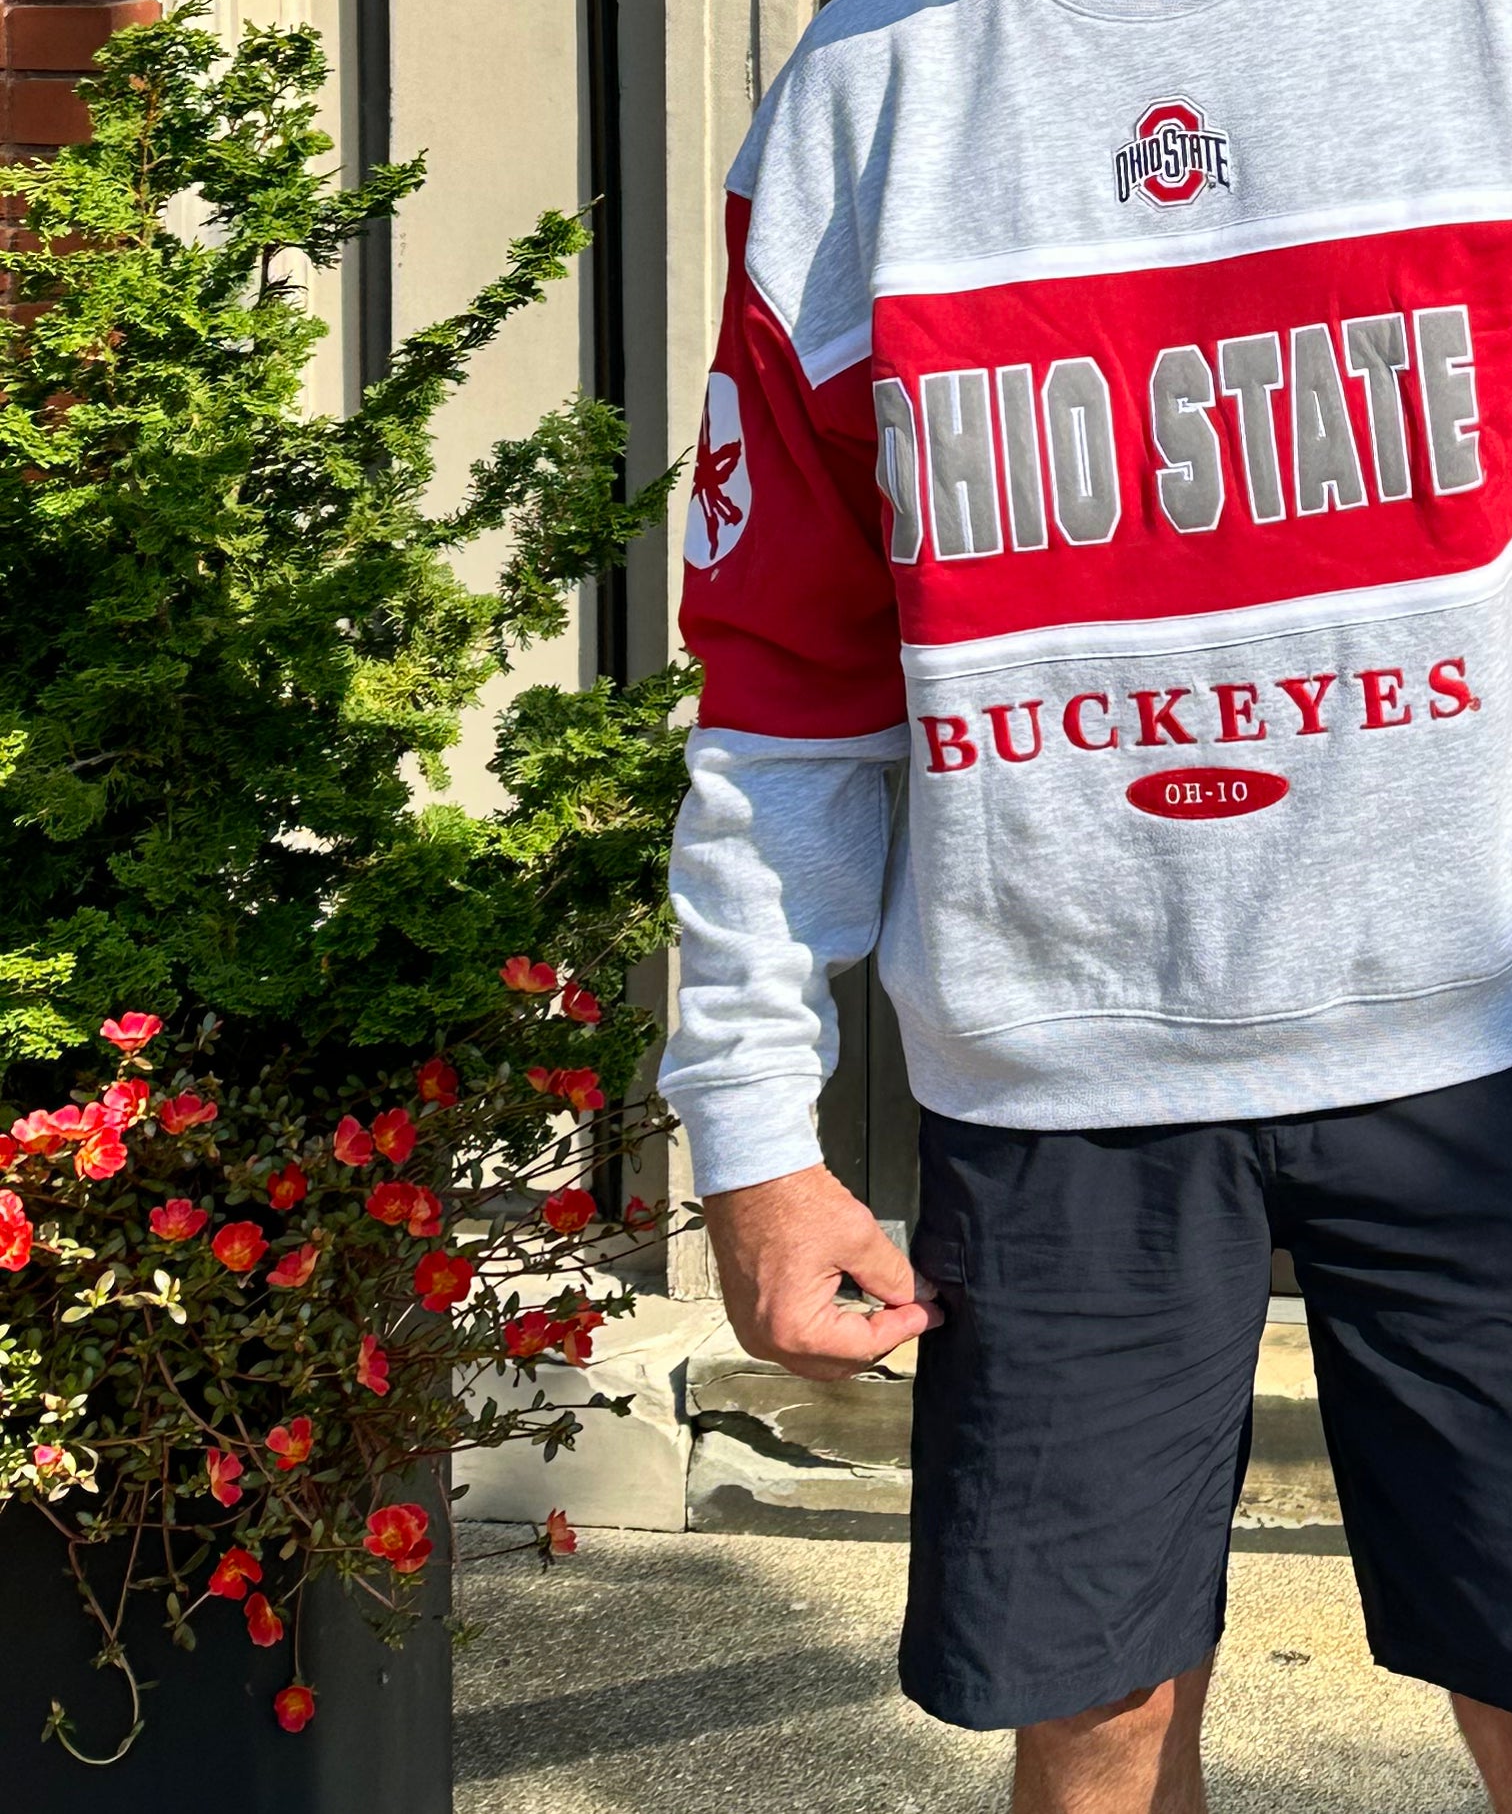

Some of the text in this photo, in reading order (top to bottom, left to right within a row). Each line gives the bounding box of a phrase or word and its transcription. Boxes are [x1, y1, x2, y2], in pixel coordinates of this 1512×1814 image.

[1115, 128, 1232, 203] OHIO STATE
[873, 304, 1484, 565] OHIO STATE
[917, 656, 1473, 774] BUCKEYES
[1164, 781, 1249, 805] OH-10
